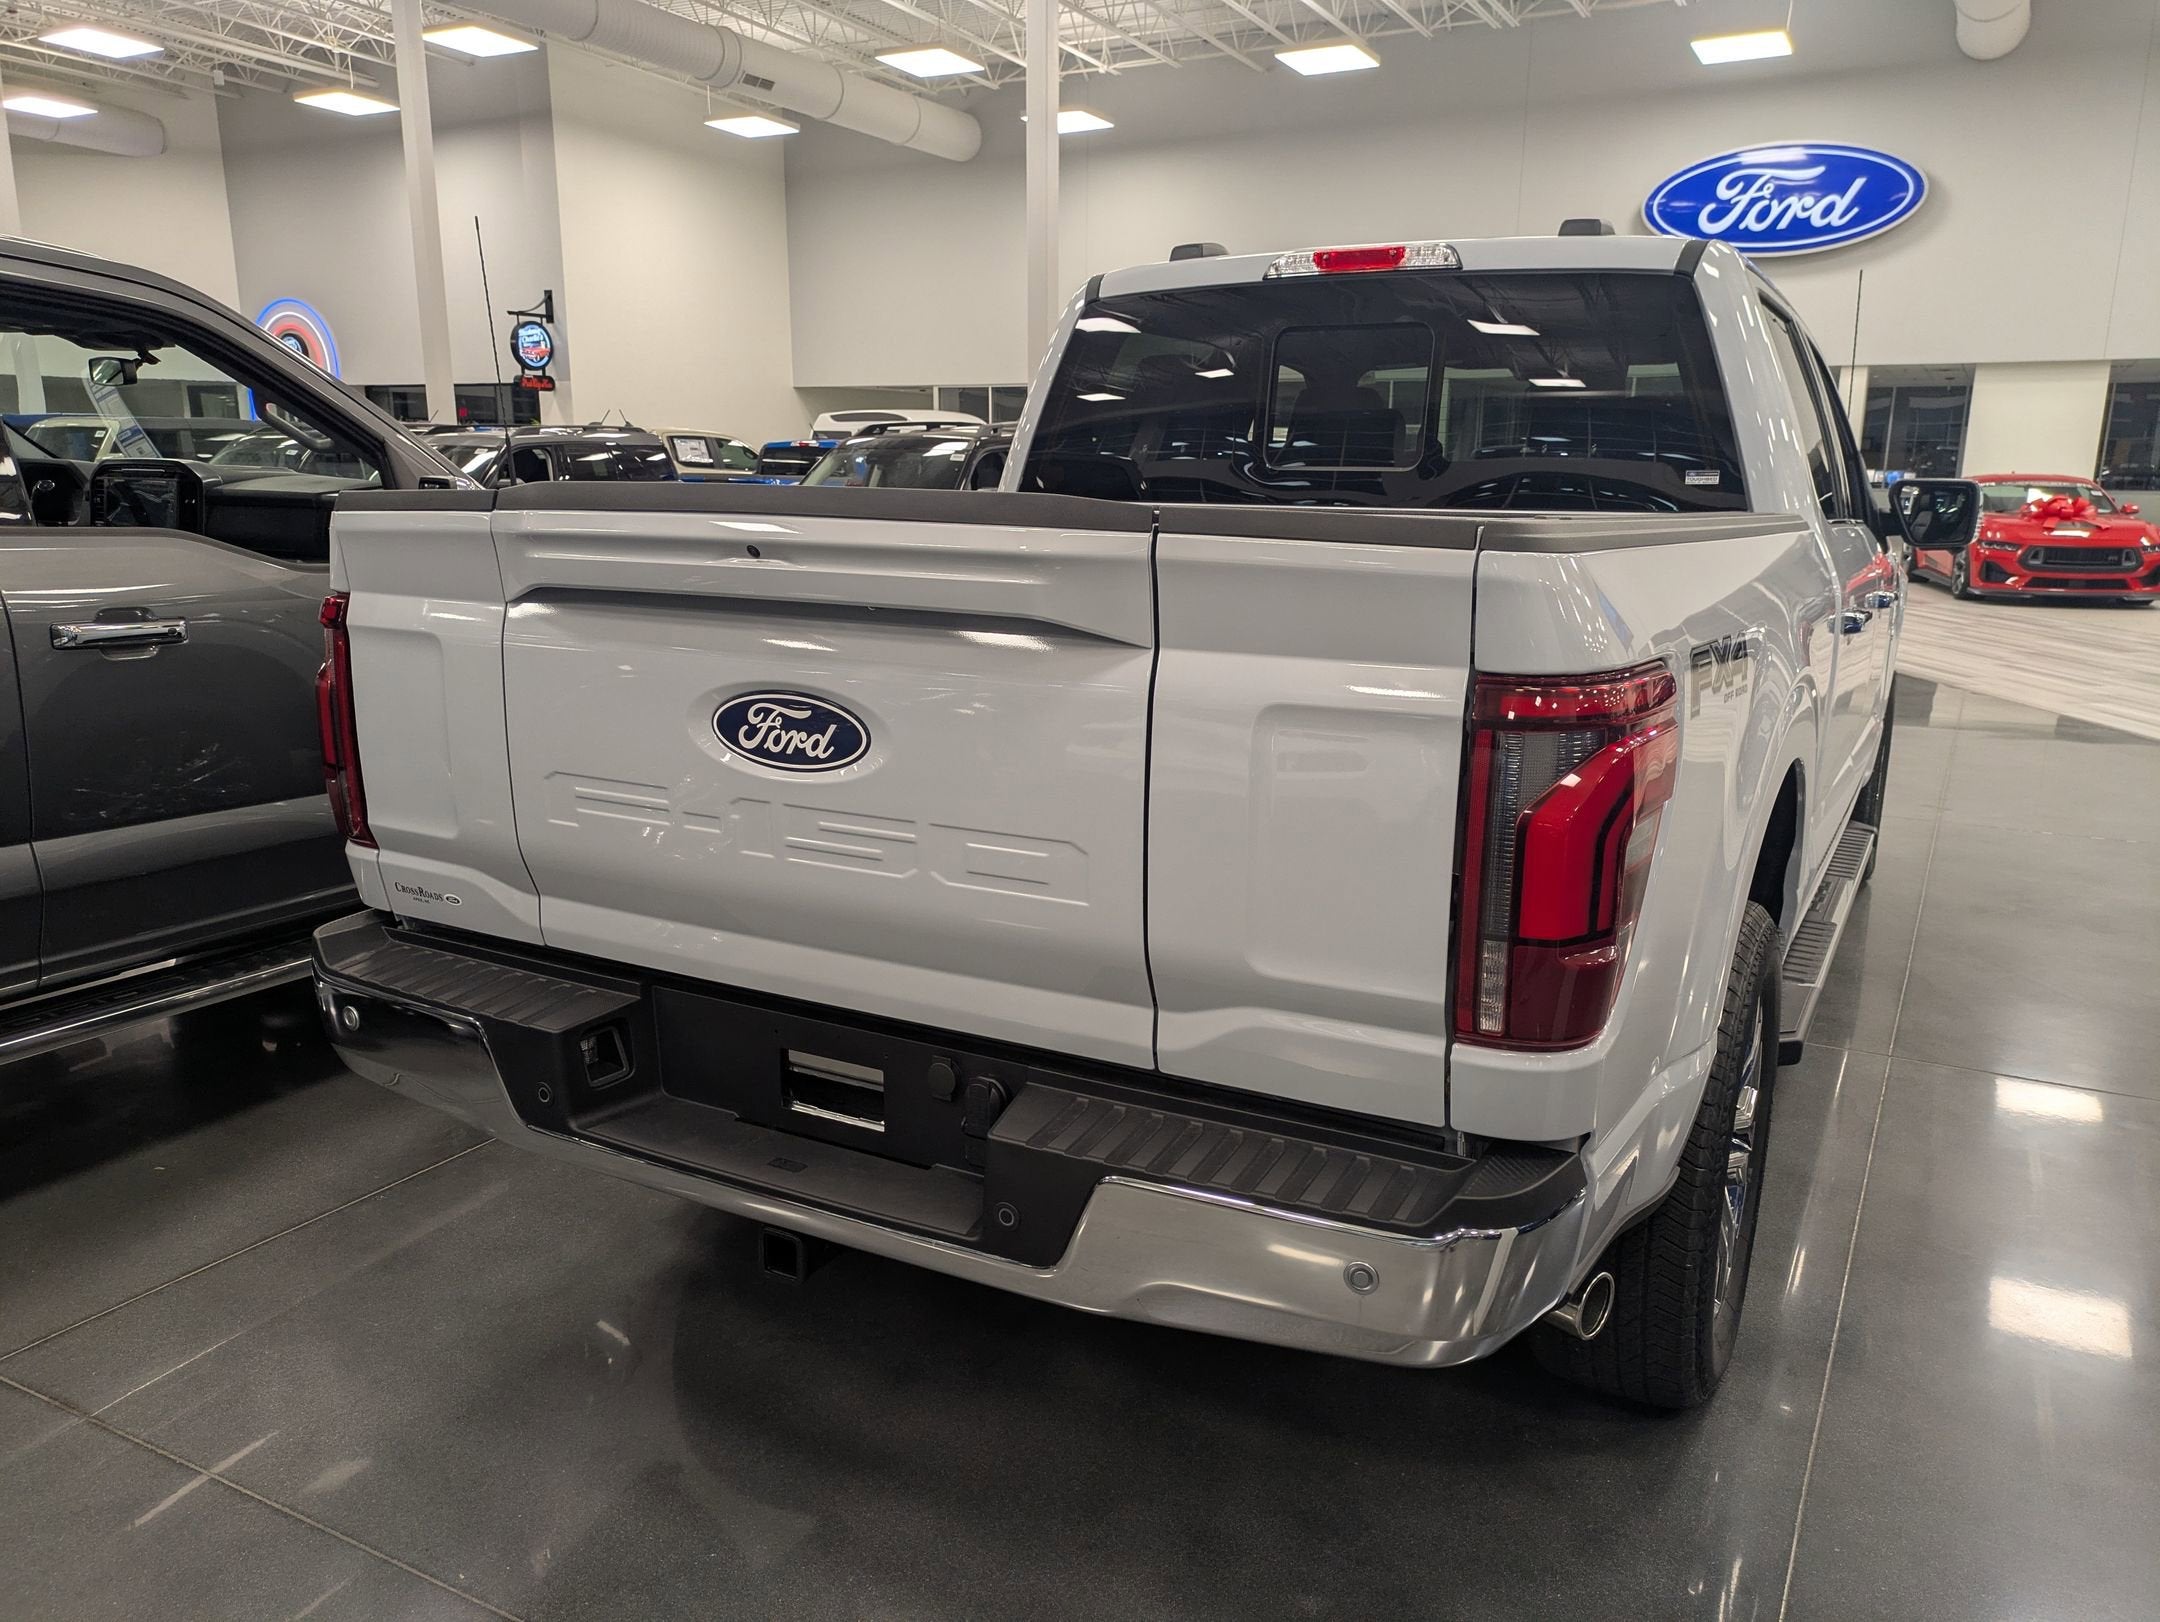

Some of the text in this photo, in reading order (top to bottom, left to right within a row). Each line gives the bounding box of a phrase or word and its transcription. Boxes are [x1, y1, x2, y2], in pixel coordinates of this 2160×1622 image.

[1697, 165, 1868, 235] Ford
[1689, 632, 1749, 720] FX4
[738, 702, 838, 760] Ford
